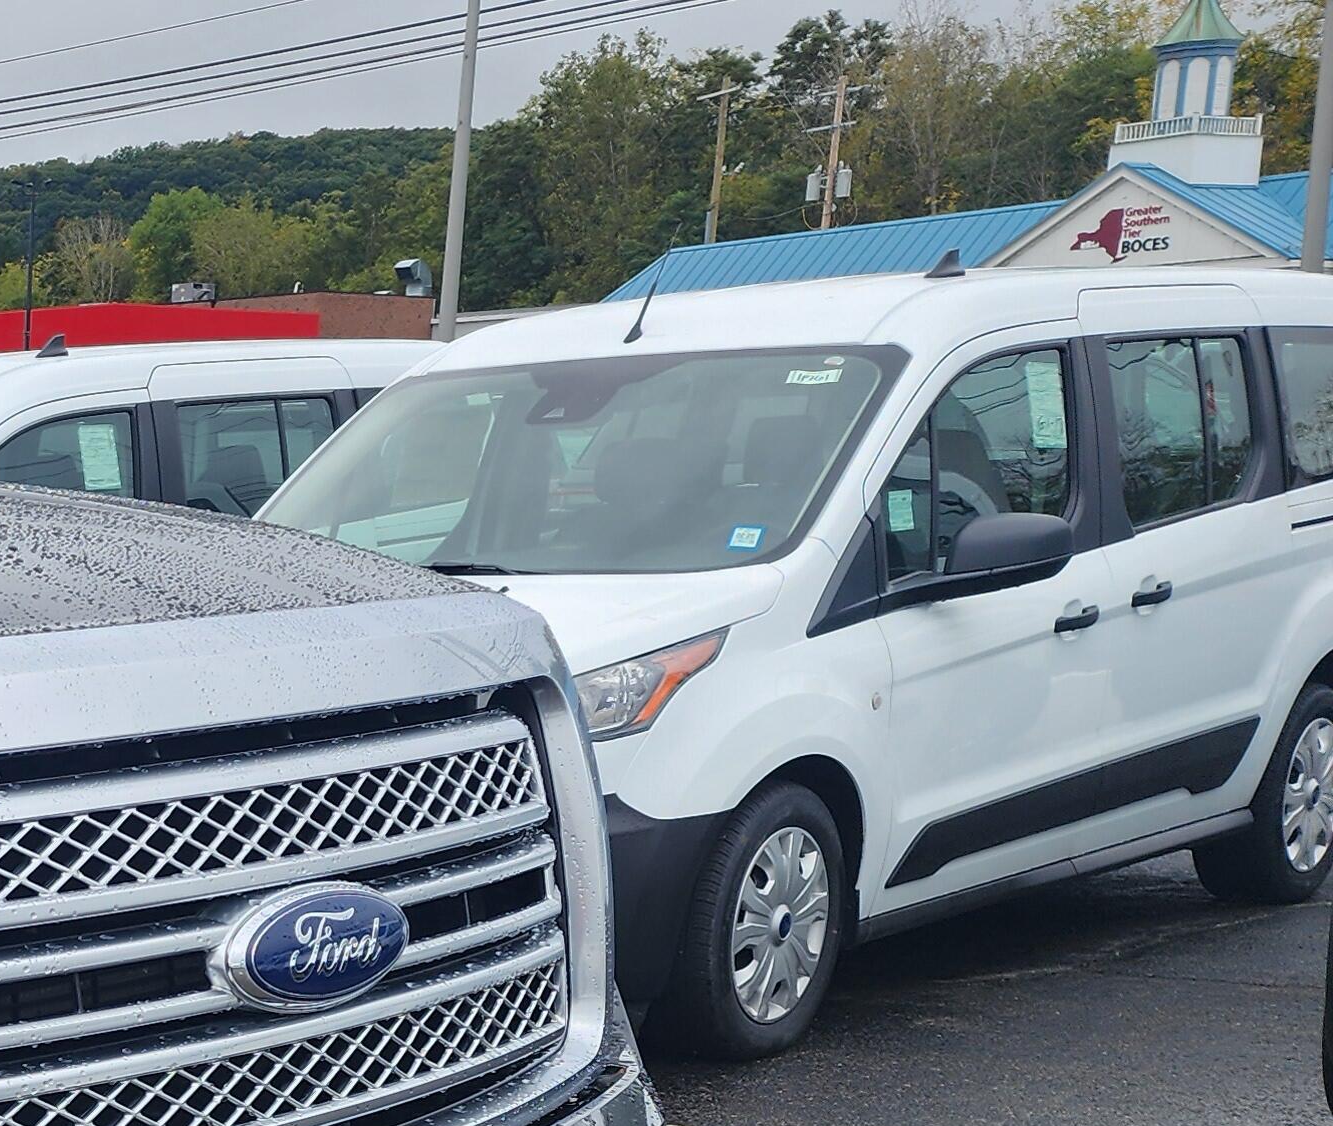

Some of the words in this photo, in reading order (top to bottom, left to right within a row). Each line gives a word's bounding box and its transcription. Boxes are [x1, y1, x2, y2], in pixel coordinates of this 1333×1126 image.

[1125, 206, 1163, 217] Greater
[1124, 216, 1171, 228] Southern
[1123, 229, 1142, 239] Tier
[1121, 236, 1170, 254] BOCES
[289, 906, 384, 978] Ford
